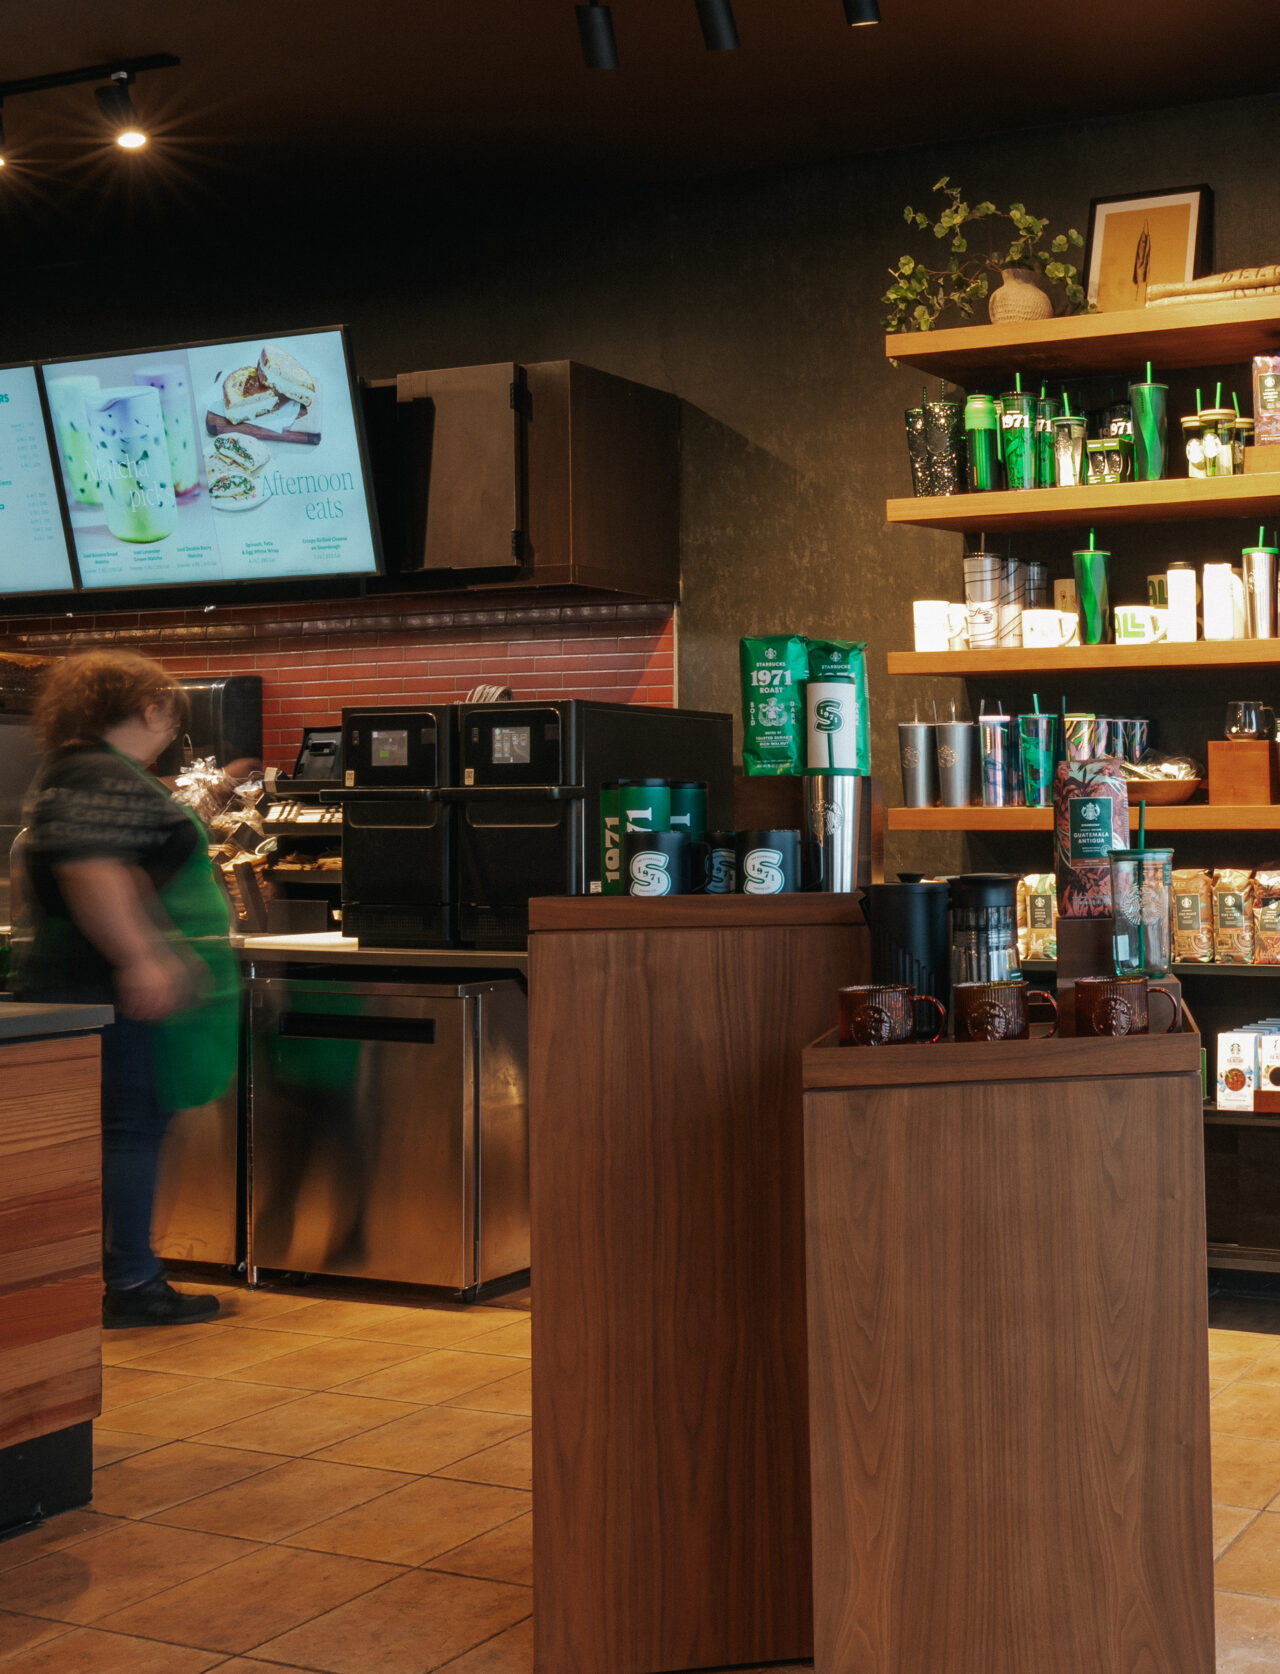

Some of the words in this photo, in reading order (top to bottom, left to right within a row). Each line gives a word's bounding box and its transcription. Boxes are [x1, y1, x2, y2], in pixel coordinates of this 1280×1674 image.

[85, 454, 148, 481] Matcha
[262, 470, 355, 496] Afternoon
[305, 497, 343, 520] eats
[750, 669, 792, 686] 1971
[605, 817, 620, 884] 1971
[638, 866, 661, 884] 1971
[752, 864, 775, 881] 1971
